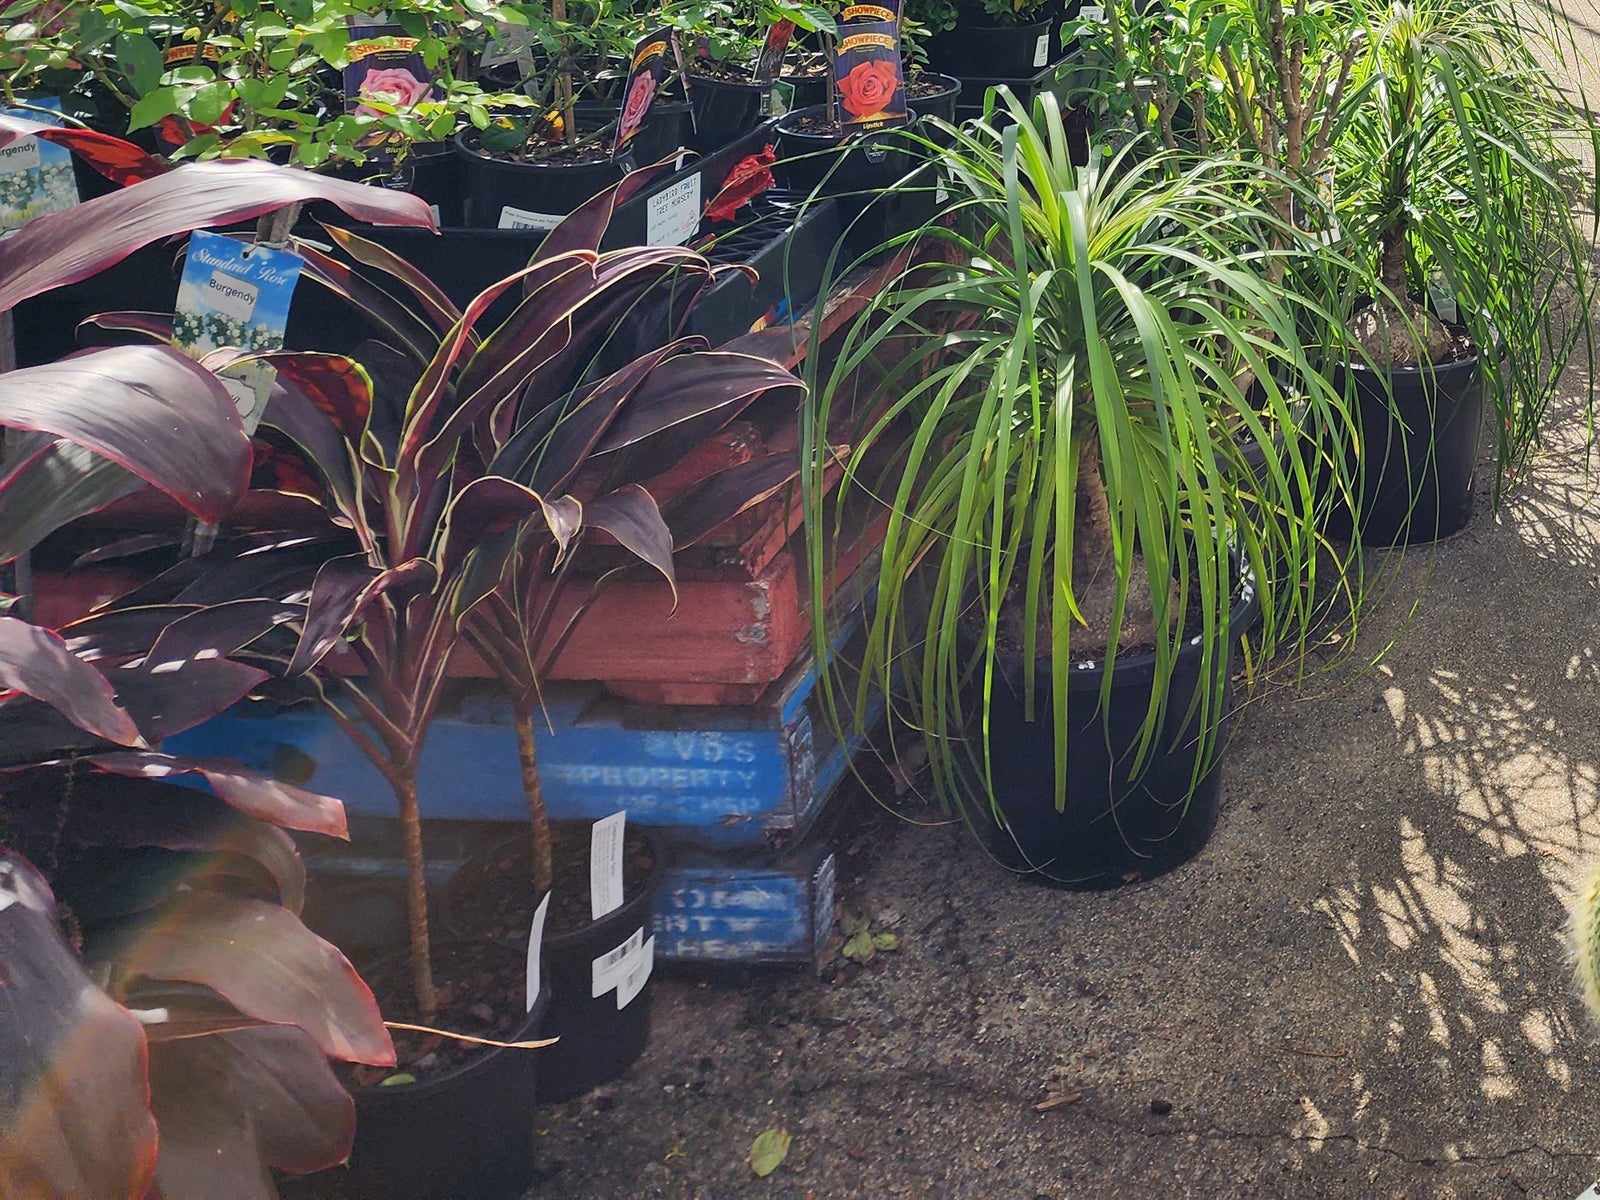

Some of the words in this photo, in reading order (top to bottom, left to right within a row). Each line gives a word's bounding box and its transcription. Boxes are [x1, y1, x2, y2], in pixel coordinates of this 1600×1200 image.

[847, 6, 892, 20] SHOWPIECE
[862, 121, 884, 130] Lipstick
[680, 177, 697, 192] FRUIT
[192, 248, 254, 275] Standard
[253, 261, 289, 287] Rose
[209, 279, 256, 305] Burgendy
[582, 765, 757, 789] PROPERTY
